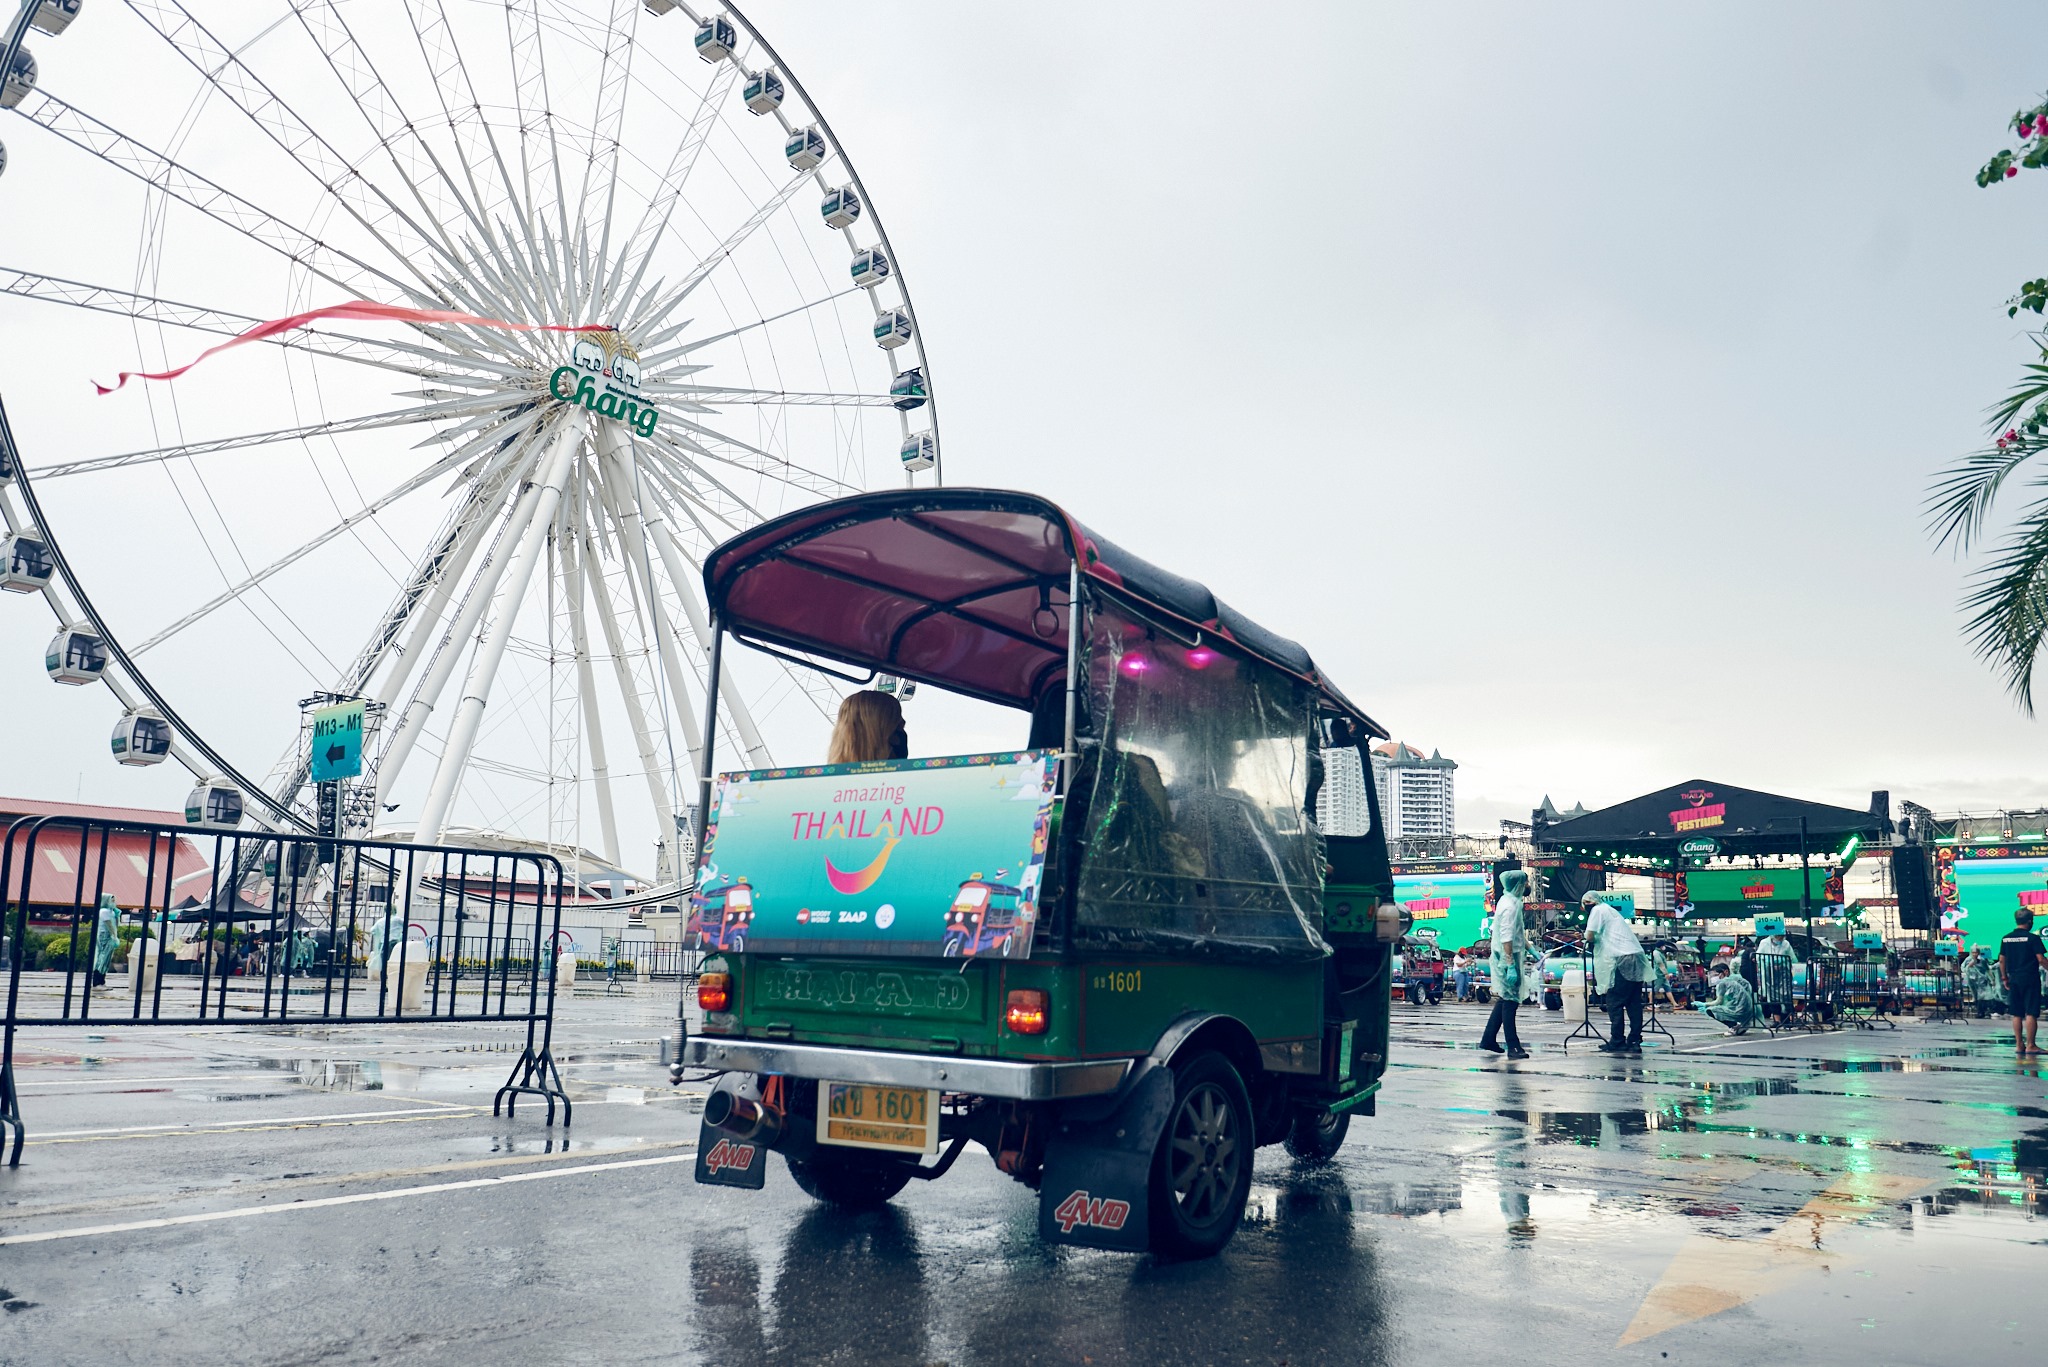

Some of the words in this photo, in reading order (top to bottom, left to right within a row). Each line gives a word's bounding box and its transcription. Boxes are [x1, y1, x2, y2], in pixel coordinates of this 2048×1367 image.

[550, 366, 659, 438] Chang
[315, 718, 337, 737] M13
[346, 712, 362, 732] M1
[833, 782, 905, 805] amazing
[791, 806, 944, 840] THAILAND
[1675, 815, 1724, 833] FESTIVAL
[1683, 842, 1715, 853] Chang
[838, 911, 868, 923] ZAAP
[1109, 970, 1141, 992] 1601
[875, 1091, 925, 1121] 1601
[706, 1138, 755, 1174] 4WD
[1055, 1190, 1130, 1233] 4WD
